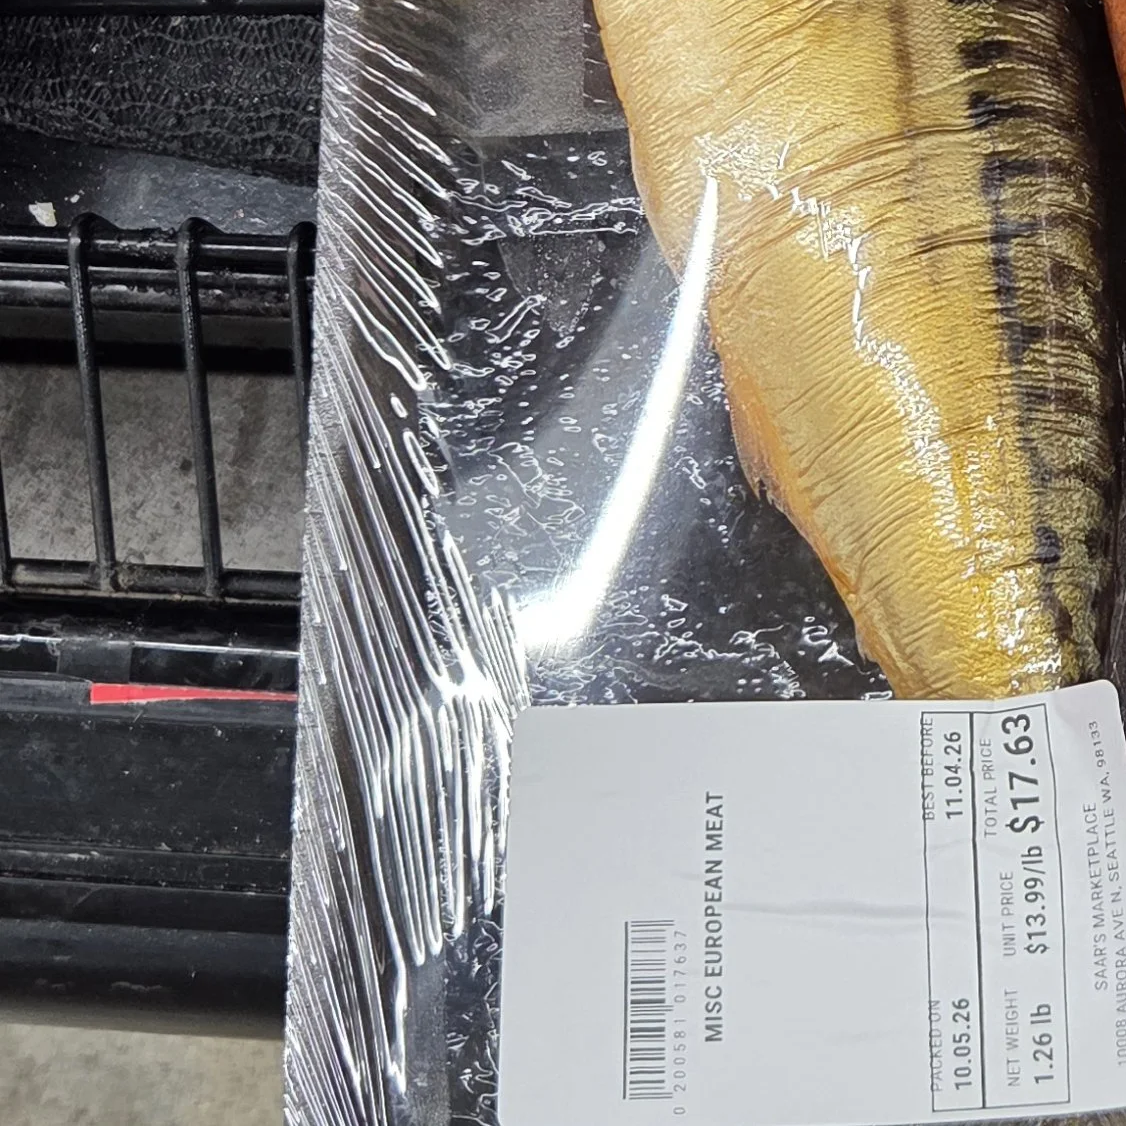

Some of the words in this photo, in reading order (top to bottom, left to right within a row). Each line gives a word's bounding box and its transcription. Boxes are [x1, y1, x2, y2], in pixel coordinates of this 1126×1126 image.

[920, 718, 934, 775] BEFORE
[980, 738, 993, 782] PRICE
[1088, 720, 1107, 768] 98133
[922, 781, 936, 821] BEST
[943, 731, 963, 820] 11.04.26
[1001, 713, 1045, 835] $17.63
[705, 790, 726, 852] MEAT
[983, 786, 997, 839] TOTAL
[1083, 803, 1105, 931] MARKETPLACE
[1104, 808, 1121, 882] SEATTLE
[704, 857, 724, 979] EUROPEAN
[999, 871, 1014, 916] PRICE
[1022, 845, 1049, 956] $13.99/lb
[1003, 922, 1016, 957] UNIT
[1112, 909, 1126, 942] AVE
[1093, 933, 1109, 992] SAAR'S
[704, 986, 724, 1044] MISC
[929, 1000, 941, 1024] ON
[1005, 987, 1020, 1051] WEIGHT
[1030, 1003, 1051, 1025] lb
[930, 1029, 944, 1093] PACKED
[952, 997, 972, 1091] 10.05.26
[1033, 1033, 1055, 1084] 1.26
[1006, 1058, 1021, 1088] NET
